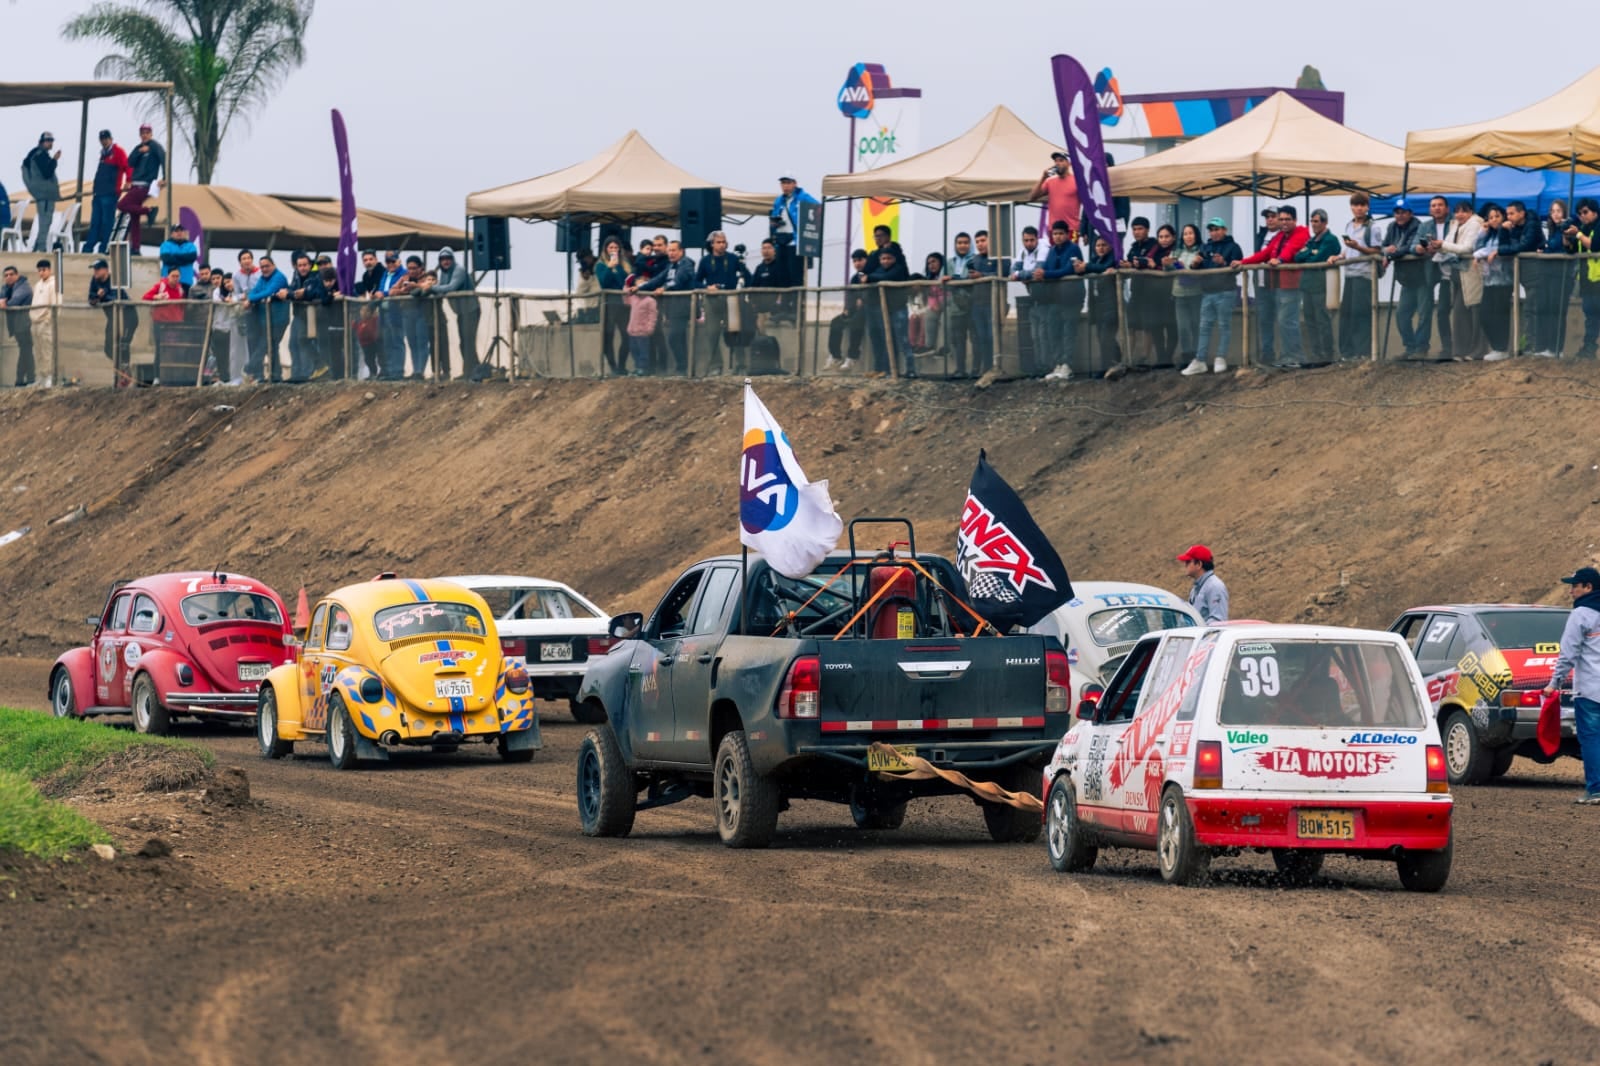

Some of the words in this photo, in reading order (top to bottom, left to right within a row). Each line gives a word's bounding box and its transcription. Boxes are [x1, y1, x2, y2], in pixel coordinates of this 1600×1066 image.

[839, 86, 870, 102] AVA
[858, 128, 896, 162] point
[181, 578, 203, 593] 7
[1425, 621, 1456, 643] 27
[543, 647, 571, 658] CAE-069
[1006, 657, 1041, 665] HILUX
[1240, 656, 1280, 697] 39
[1227, 731, 1269, 744] Valeo
[1350, 733, 1418, 744] ACDelco
[1272, 751, 1302, 772] IZA
[1307, 751, 1378, 774] MOTORS
[1125, 791, 1144, 806] DENSO
[1299, 819, 1351, 836] BQW-515
